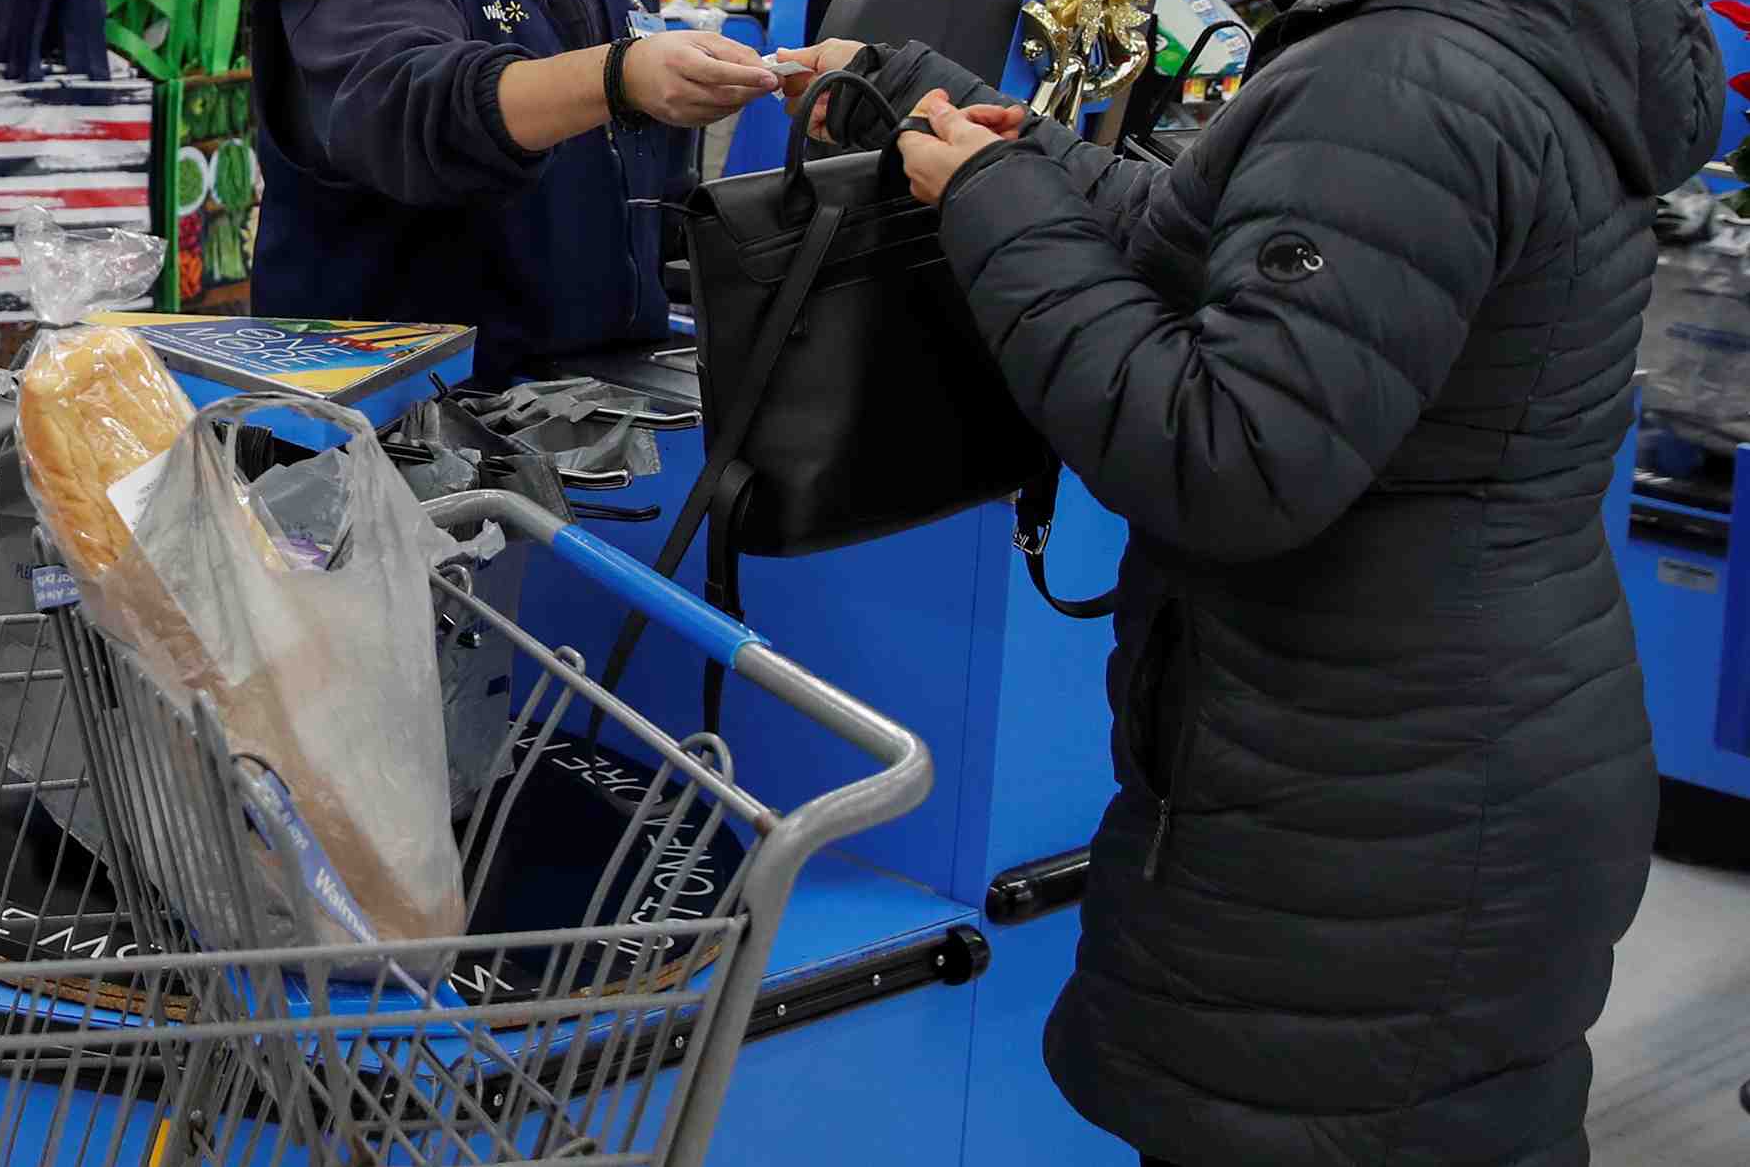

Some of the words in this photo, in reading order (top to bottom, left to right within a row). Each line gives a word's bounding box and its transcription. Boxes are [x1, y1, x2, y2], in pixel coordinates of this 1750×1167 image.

[172, 327, 327, 367] MORE
[236, 328, 353, 364] ONE
[315, 867, 379, 946] Walma
